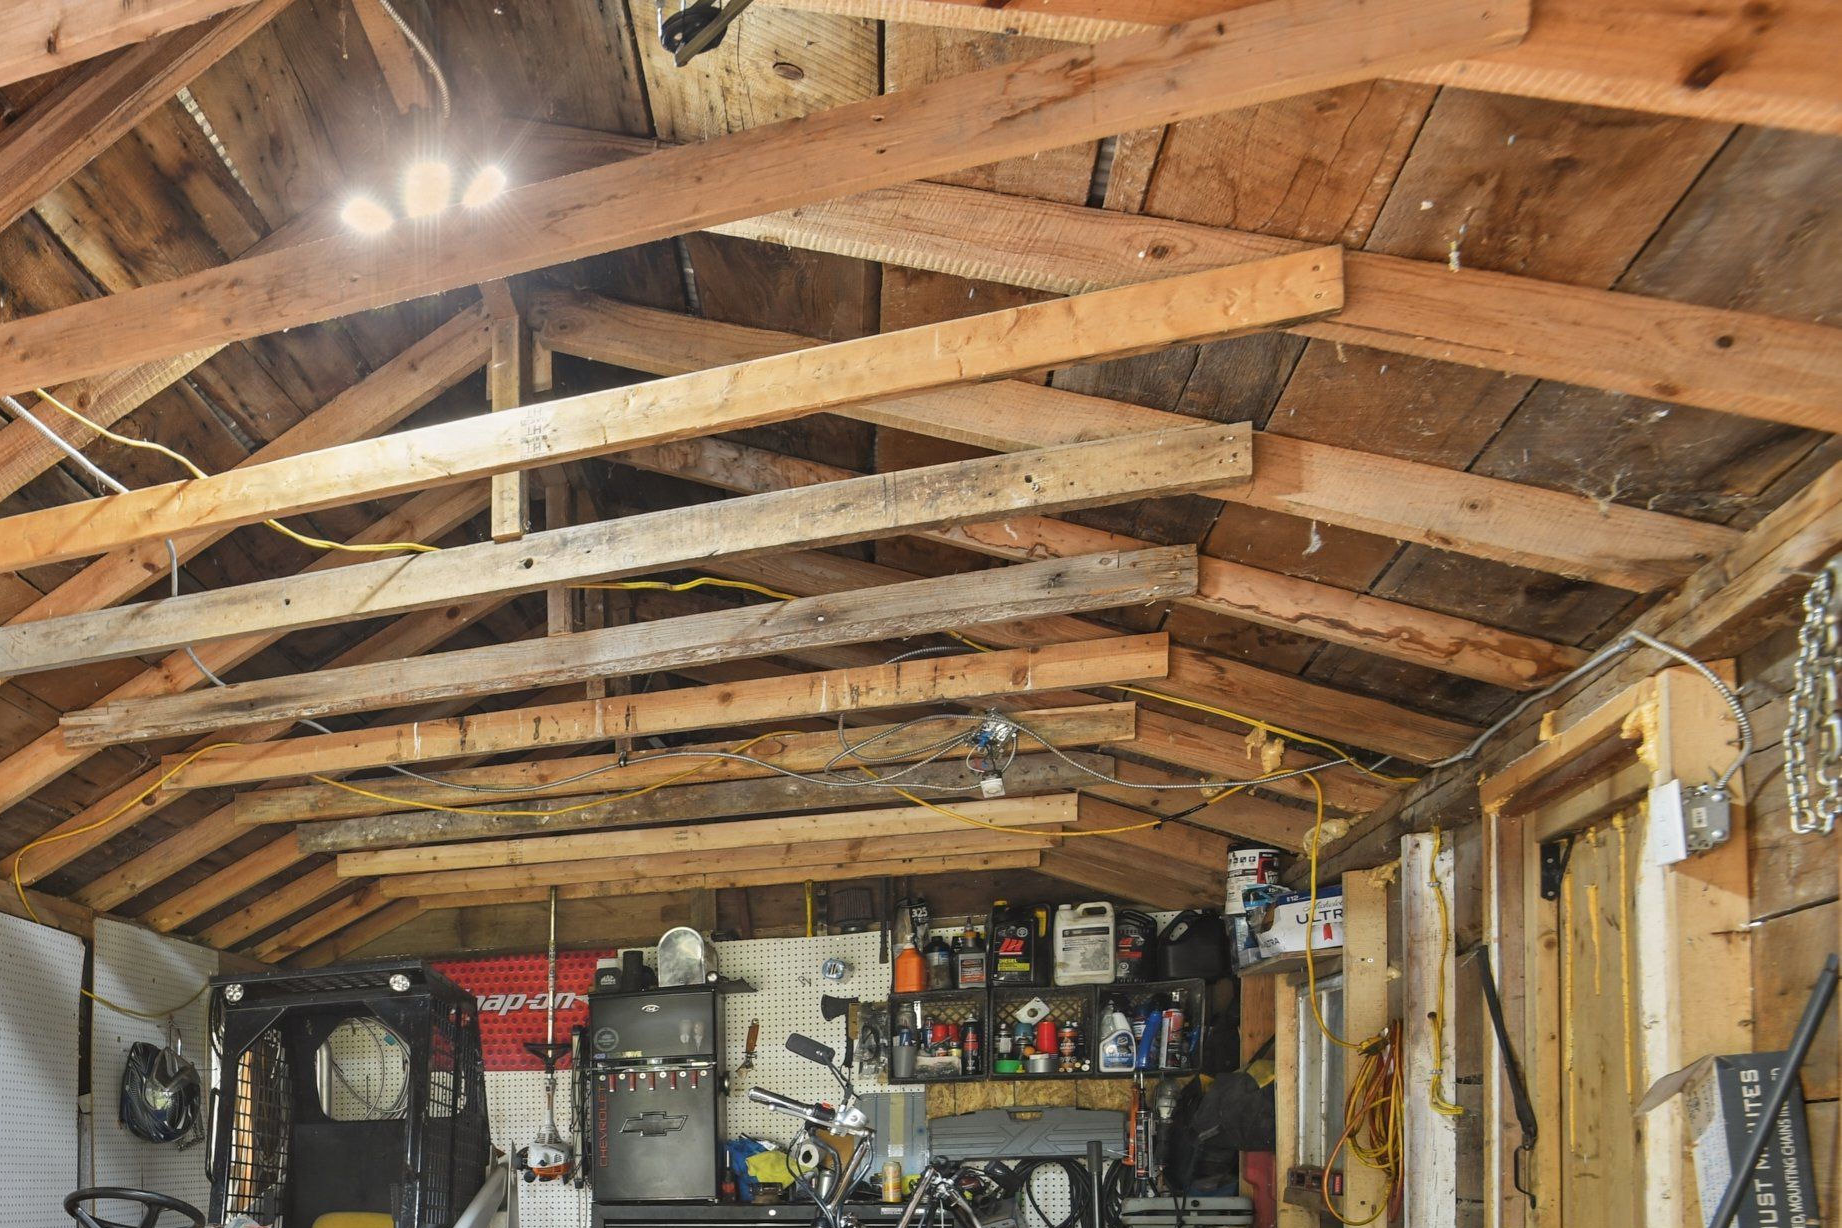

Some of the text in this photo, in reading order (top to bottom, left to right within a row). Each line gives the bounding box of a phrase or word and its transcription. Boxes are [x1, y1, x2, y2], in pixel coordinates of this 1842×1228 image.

[599, 1085, 608, 1167] CHEVROLET
[1777, 1117, 1796, 1157] CHAINS
[1782, 1157, 1803, 1214] MOUNTING
